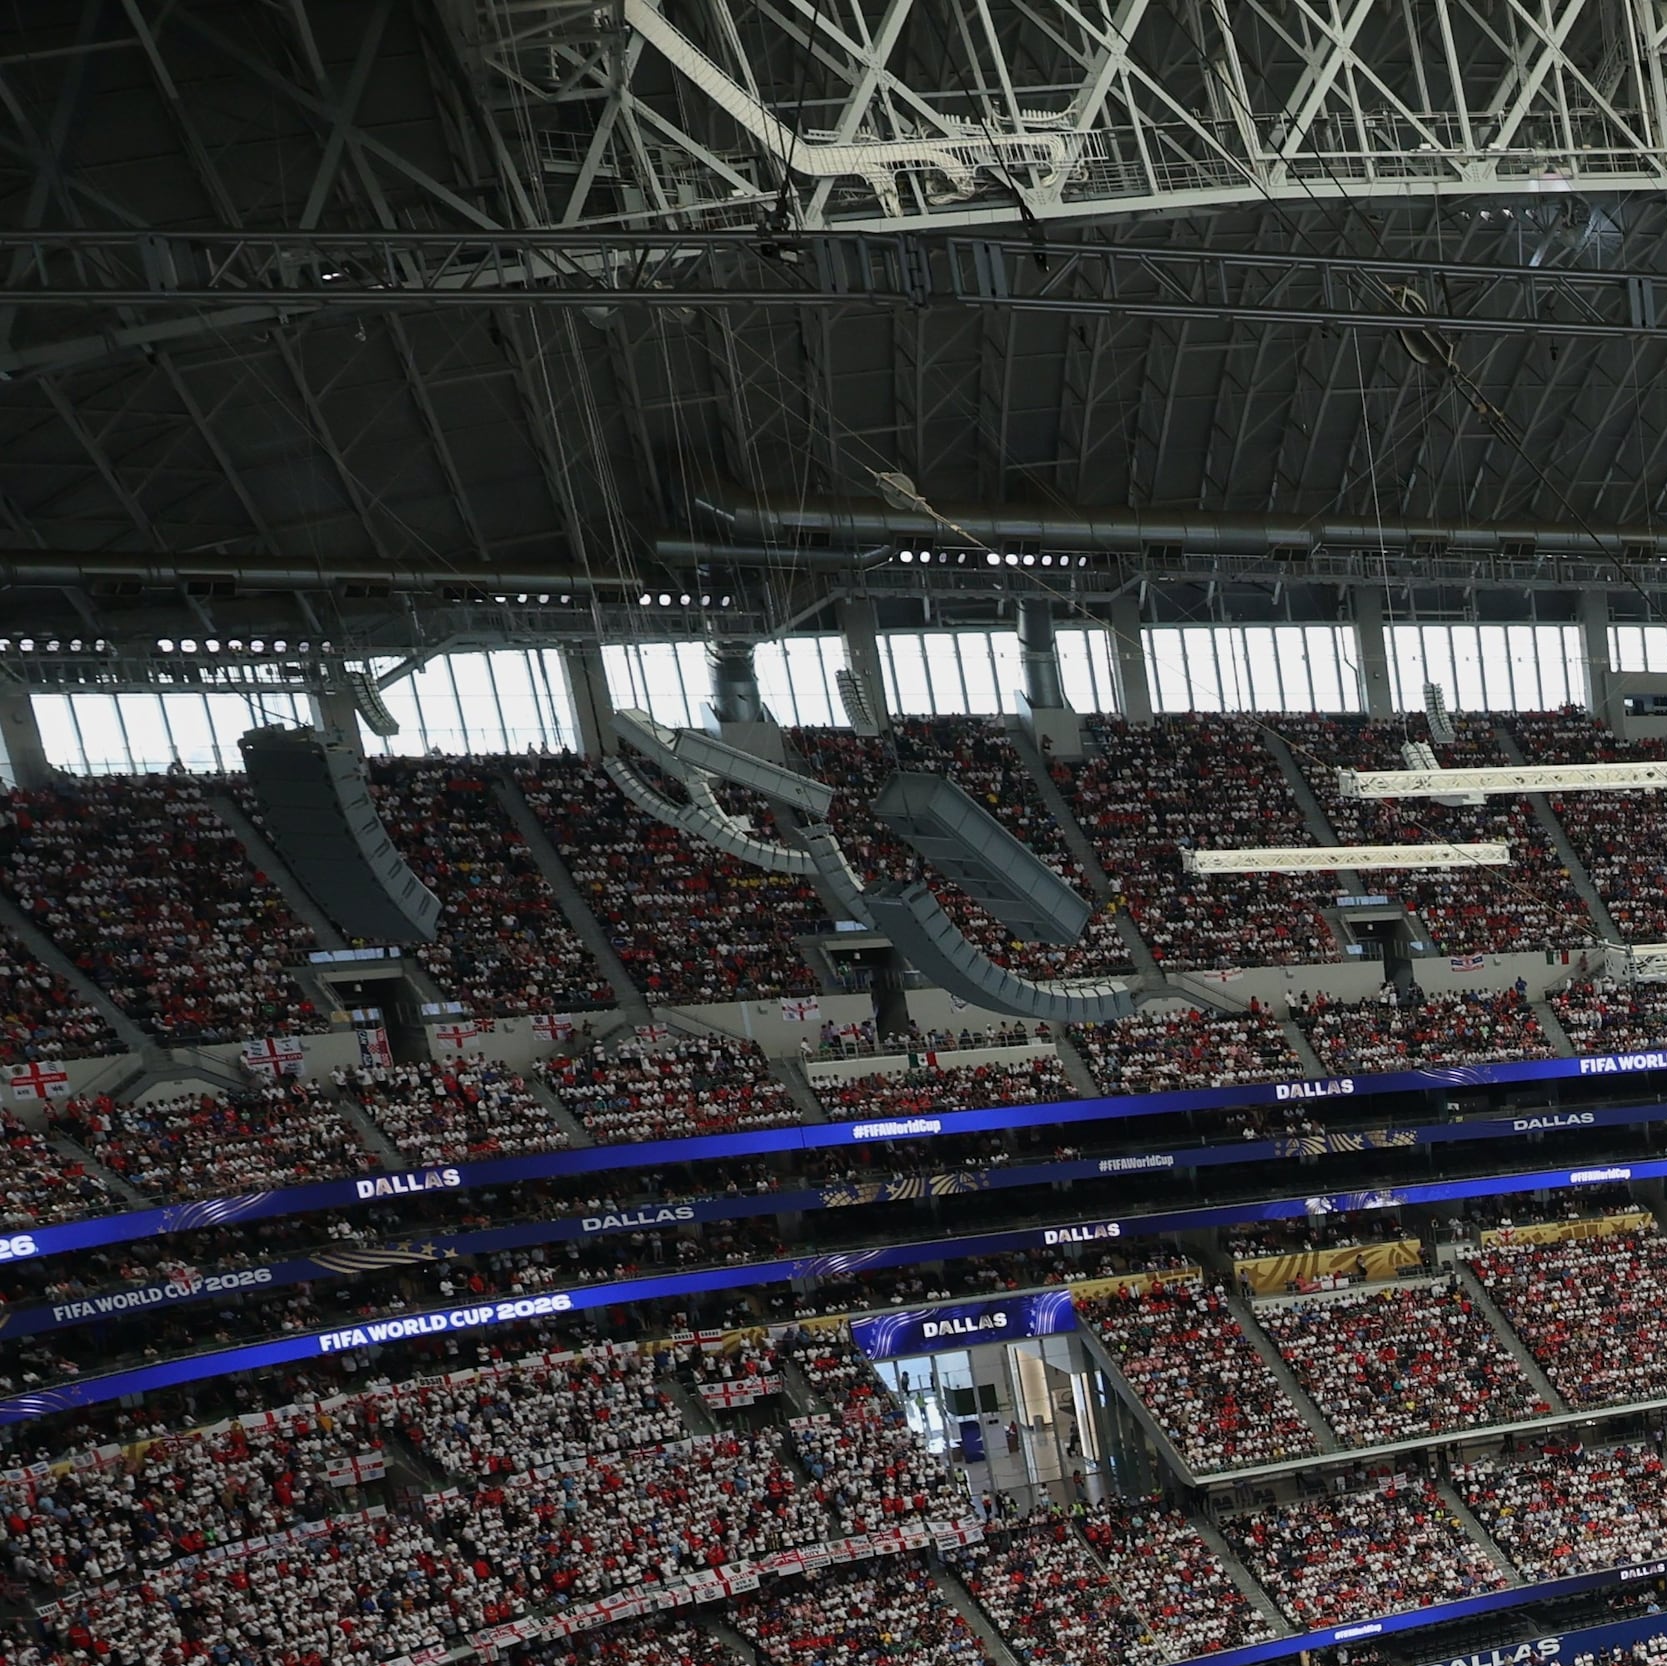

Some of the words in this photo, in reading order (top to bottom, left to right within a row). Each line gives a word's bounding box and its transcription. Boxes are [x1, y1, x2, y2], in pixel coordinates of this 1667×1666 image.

[1580, 1058, 1616, 1073] FIFA
[1276, 1079, 1353, 1099] DALLAS
[853, 1119, 941, 1138] #FIFAWorldCup
[1514, 1112, 1594, 1131] DALLAS
[1099, 1155, 1173, 1171] #FIFAWorldCup
[357, 1169, 460, 1198] DALLAS
[582, 1206, 695, 1232] DALLAS
[1044, 1222, 1120, 1245] DALLAS
[53, 1302, 93, 1321] FIFA
[95, 1288, 166, 1312] WORLD
[205, 1269, 272, 1291] 2026
[320, 1329, 368, 1351] FIFA
[370, 1315, 447, 1341] WORLD
[450, 1307, 493, 1327] CUP
[496, 1295, 572, 1320] 2026
[923, 1312, 1007, 1338] DALLAS
[1620, 1563, 1665, 1580] DALLAS
